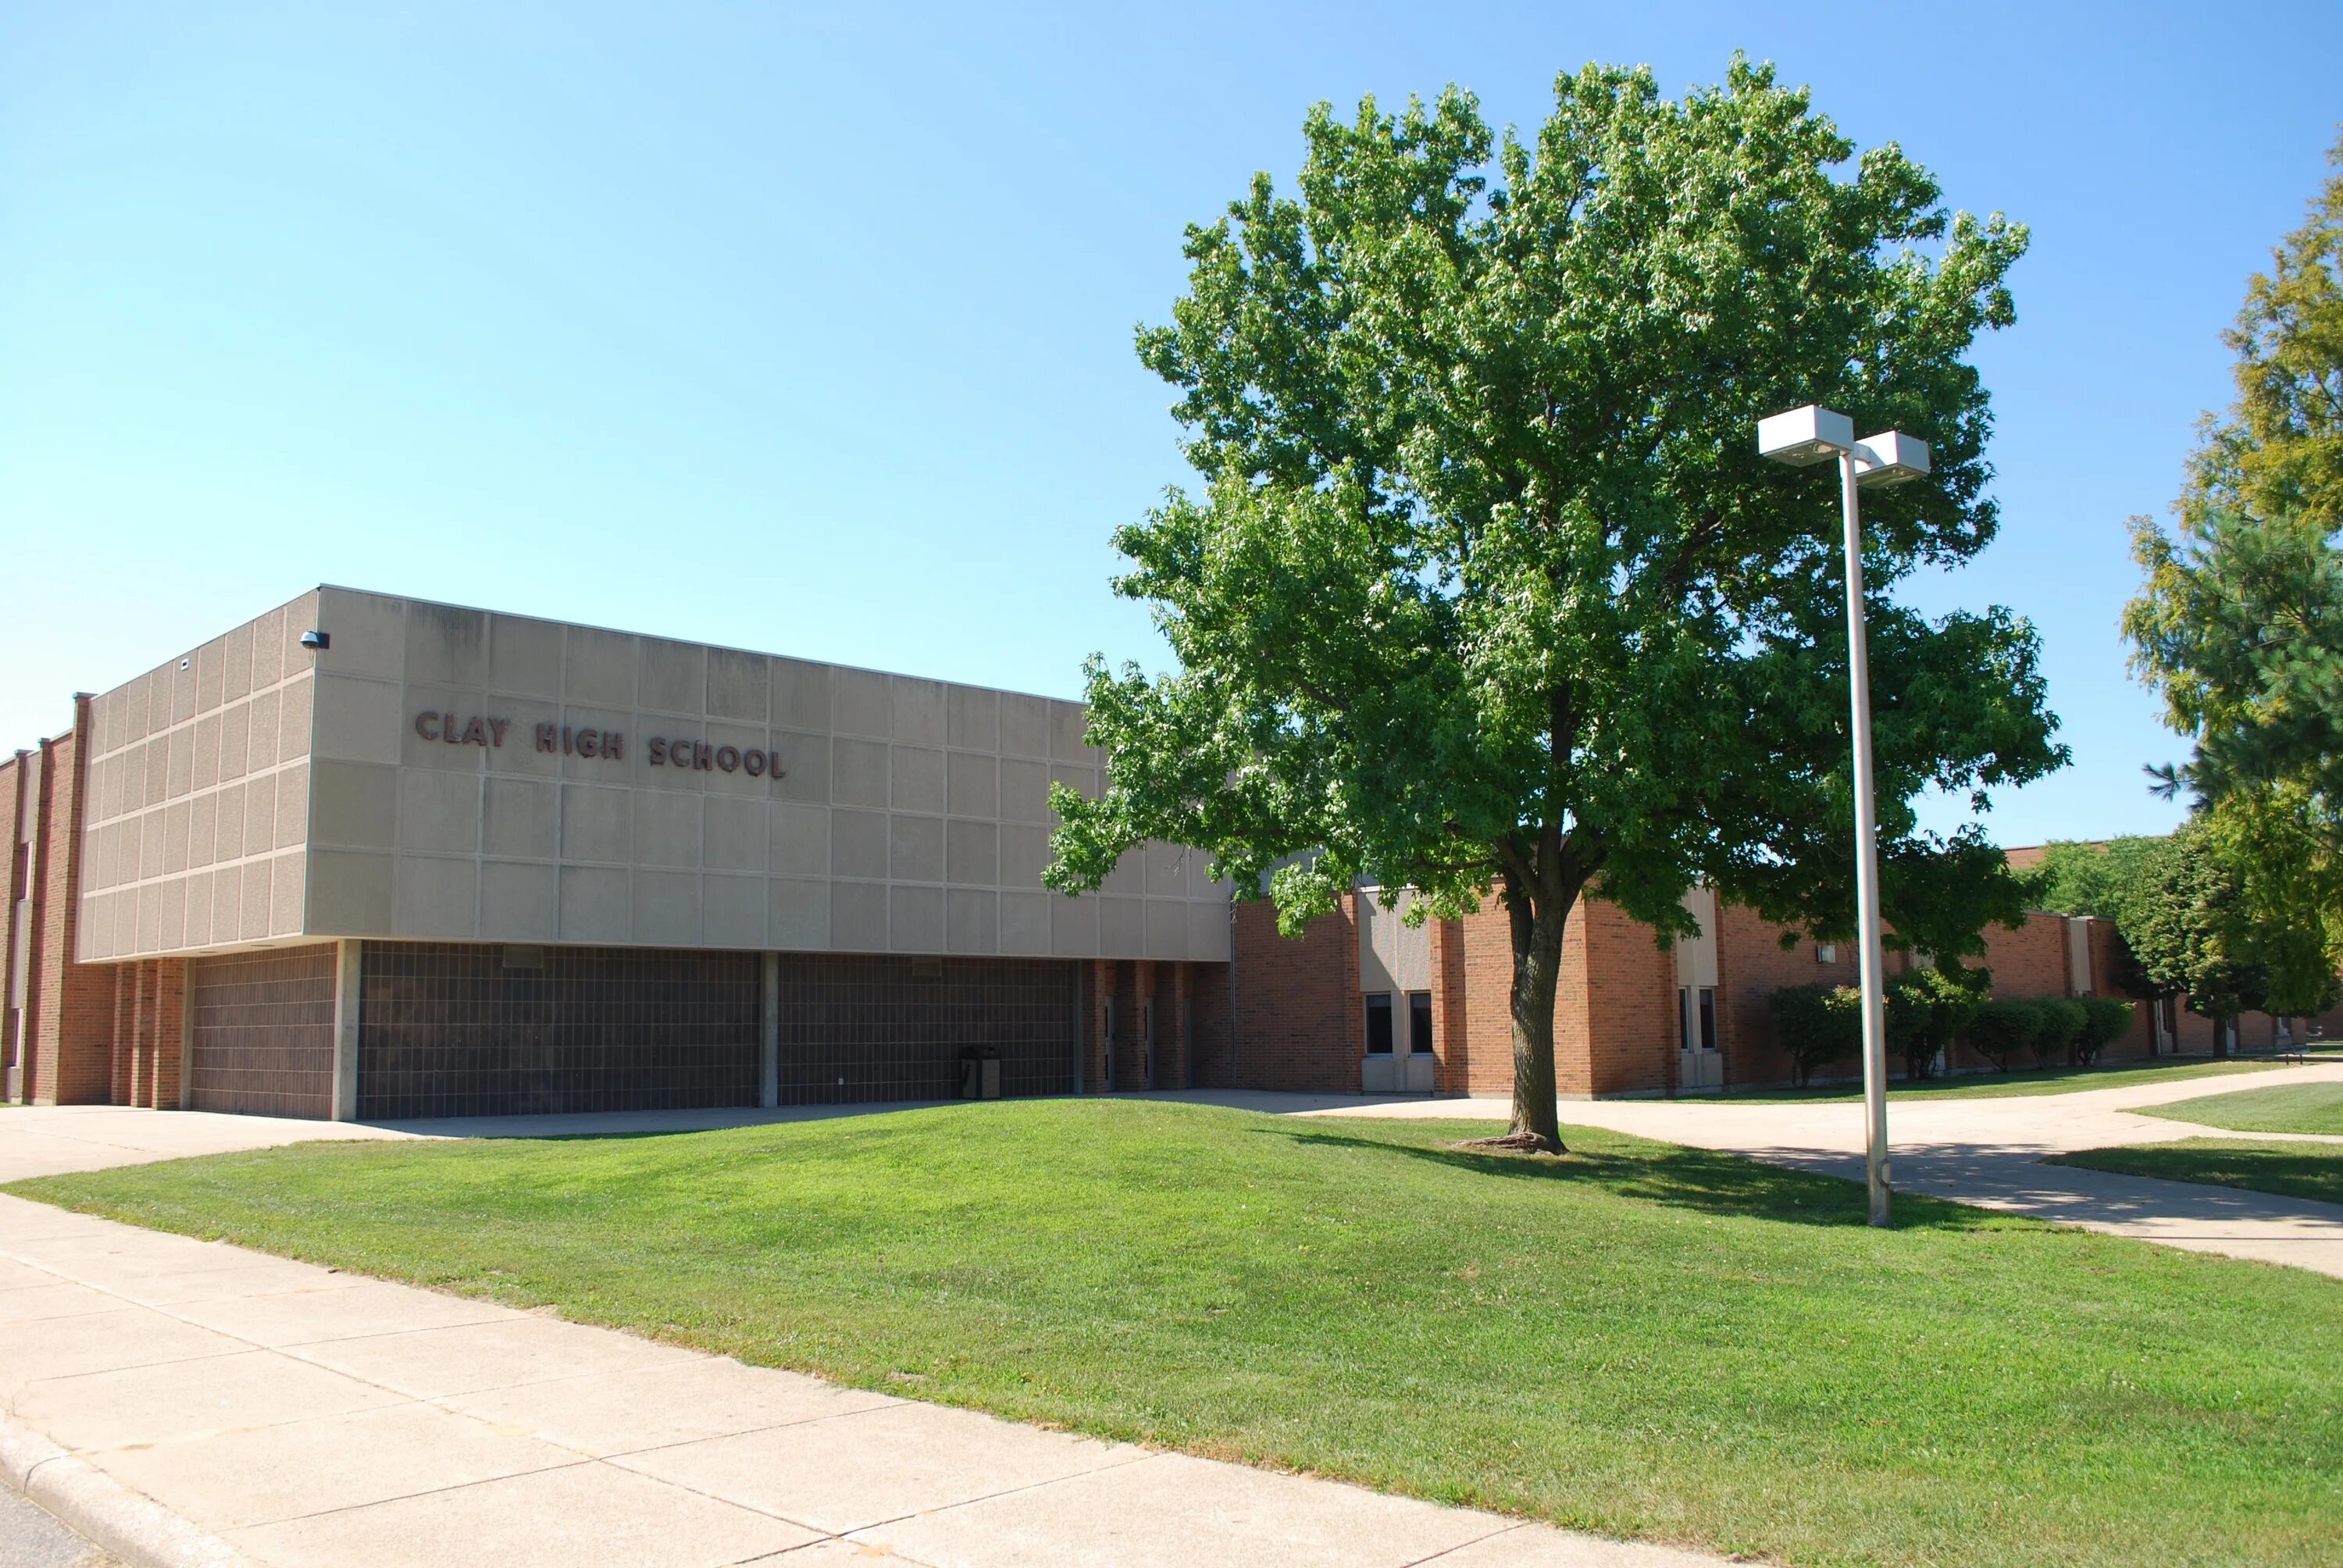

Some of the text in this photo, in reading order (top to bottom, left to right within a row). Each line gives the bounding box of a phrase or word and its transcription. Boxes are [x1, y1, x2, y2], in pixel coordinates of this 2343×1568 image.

[415, 711, 785, 779] CLAY HIGH SCHOOL
